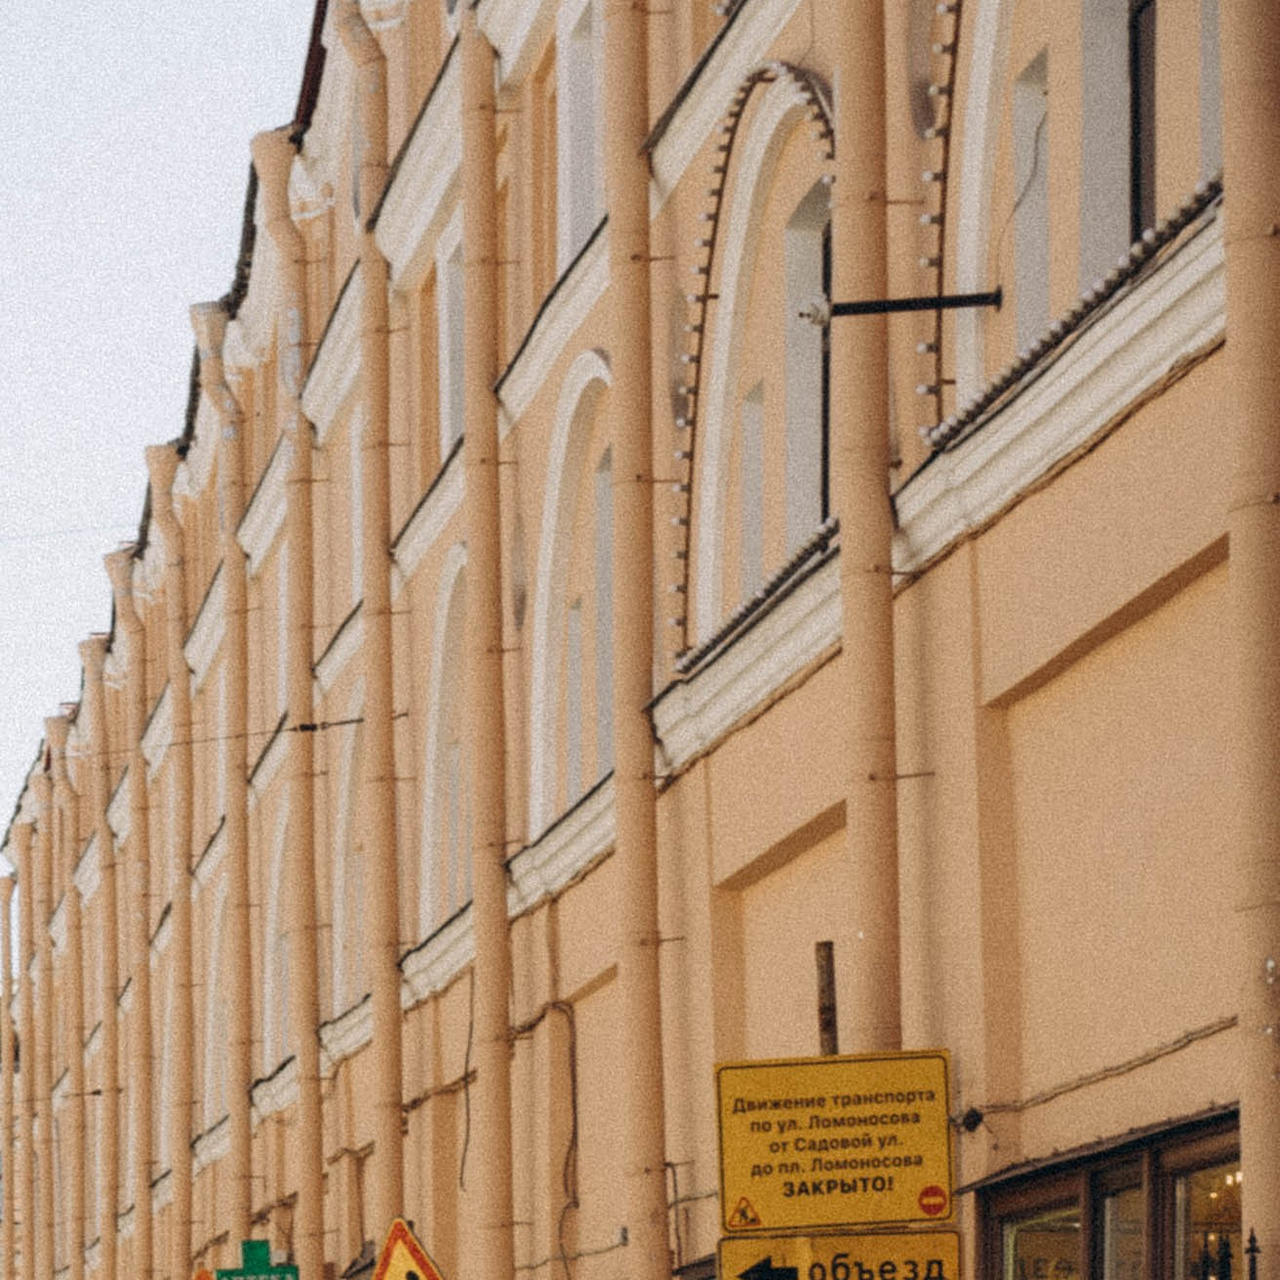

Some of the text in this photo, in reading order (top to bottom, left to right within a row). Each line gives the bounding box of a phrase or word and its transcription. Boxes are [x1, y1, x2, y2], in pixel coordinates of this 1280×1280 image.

[732, 1089, 936, 1114] Движение транспорта
[750, 1112, 921, 1134] по ул. Ломоносова
[770, 1134, 904, 1153] от Садовой ул.
[751, 1154, 923, 1178] до пл. Ломоносова
[783, 1176, 894, 1198] ЗАКРЫТО!
